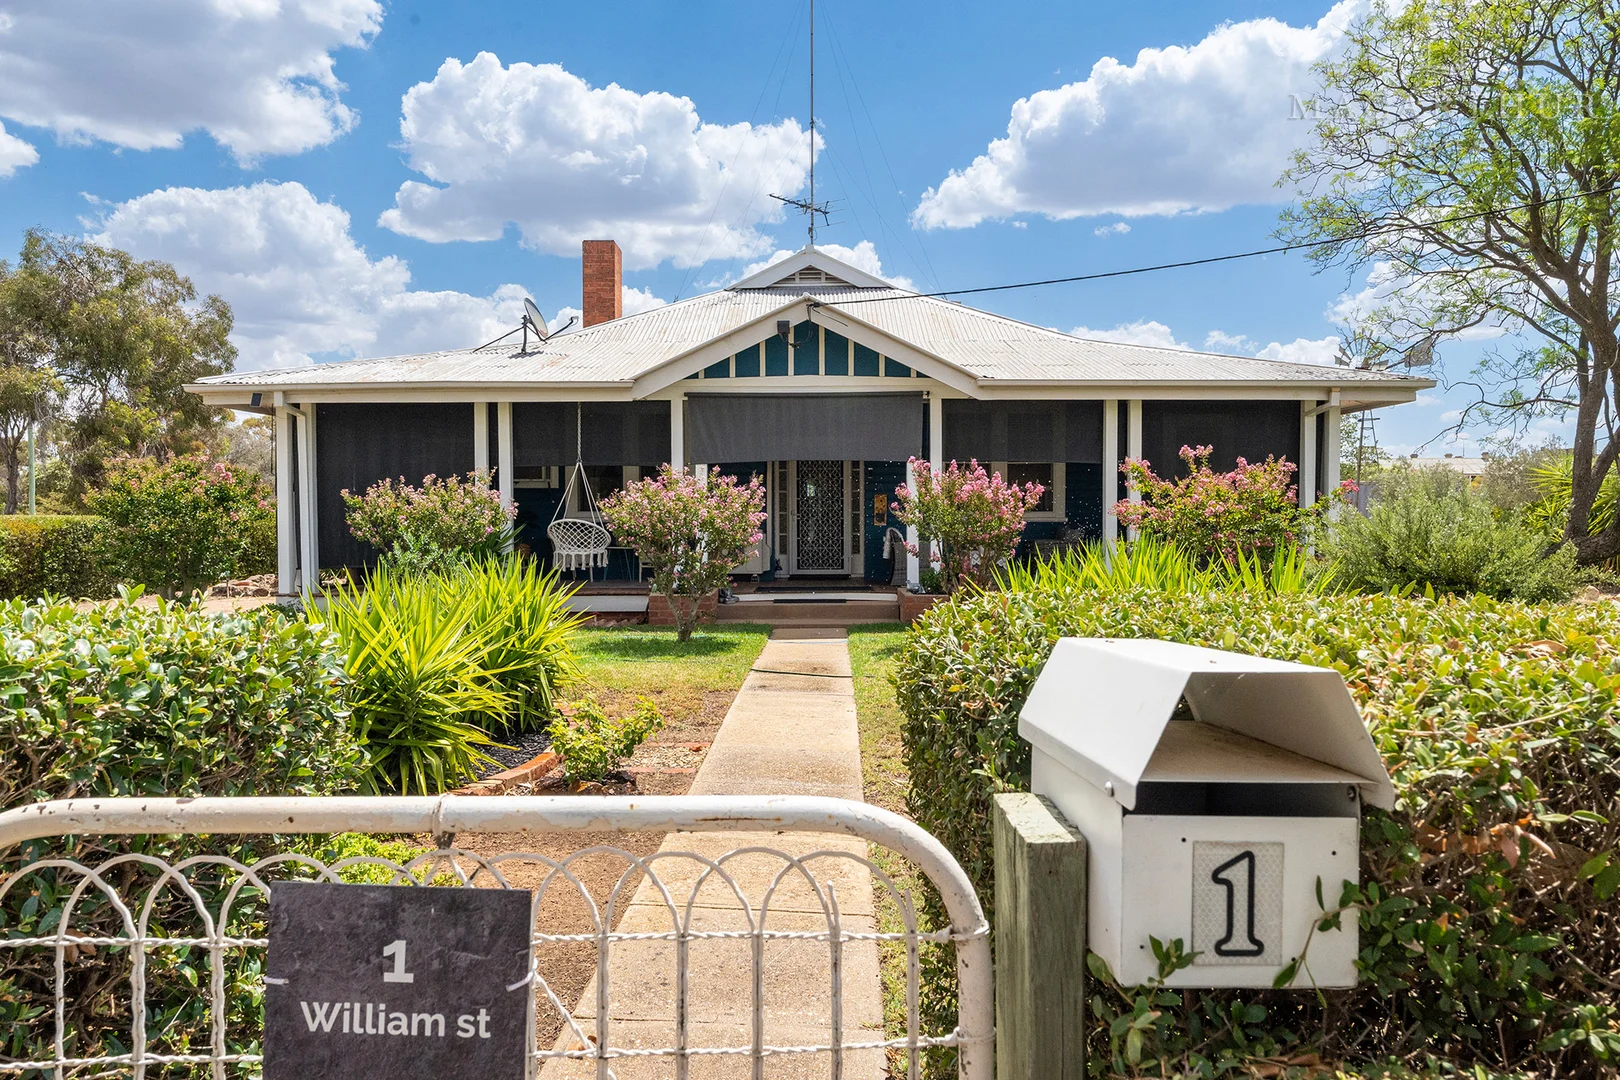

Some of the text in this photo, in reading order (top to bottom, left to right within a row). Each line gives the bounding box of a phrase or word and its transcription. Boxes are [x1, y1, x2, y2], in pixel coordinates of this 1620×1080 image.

[1211, 850, 1265, 957] 1
[383, 939, 414, 983] 1
[300, 1001, 491, 1039] William st
